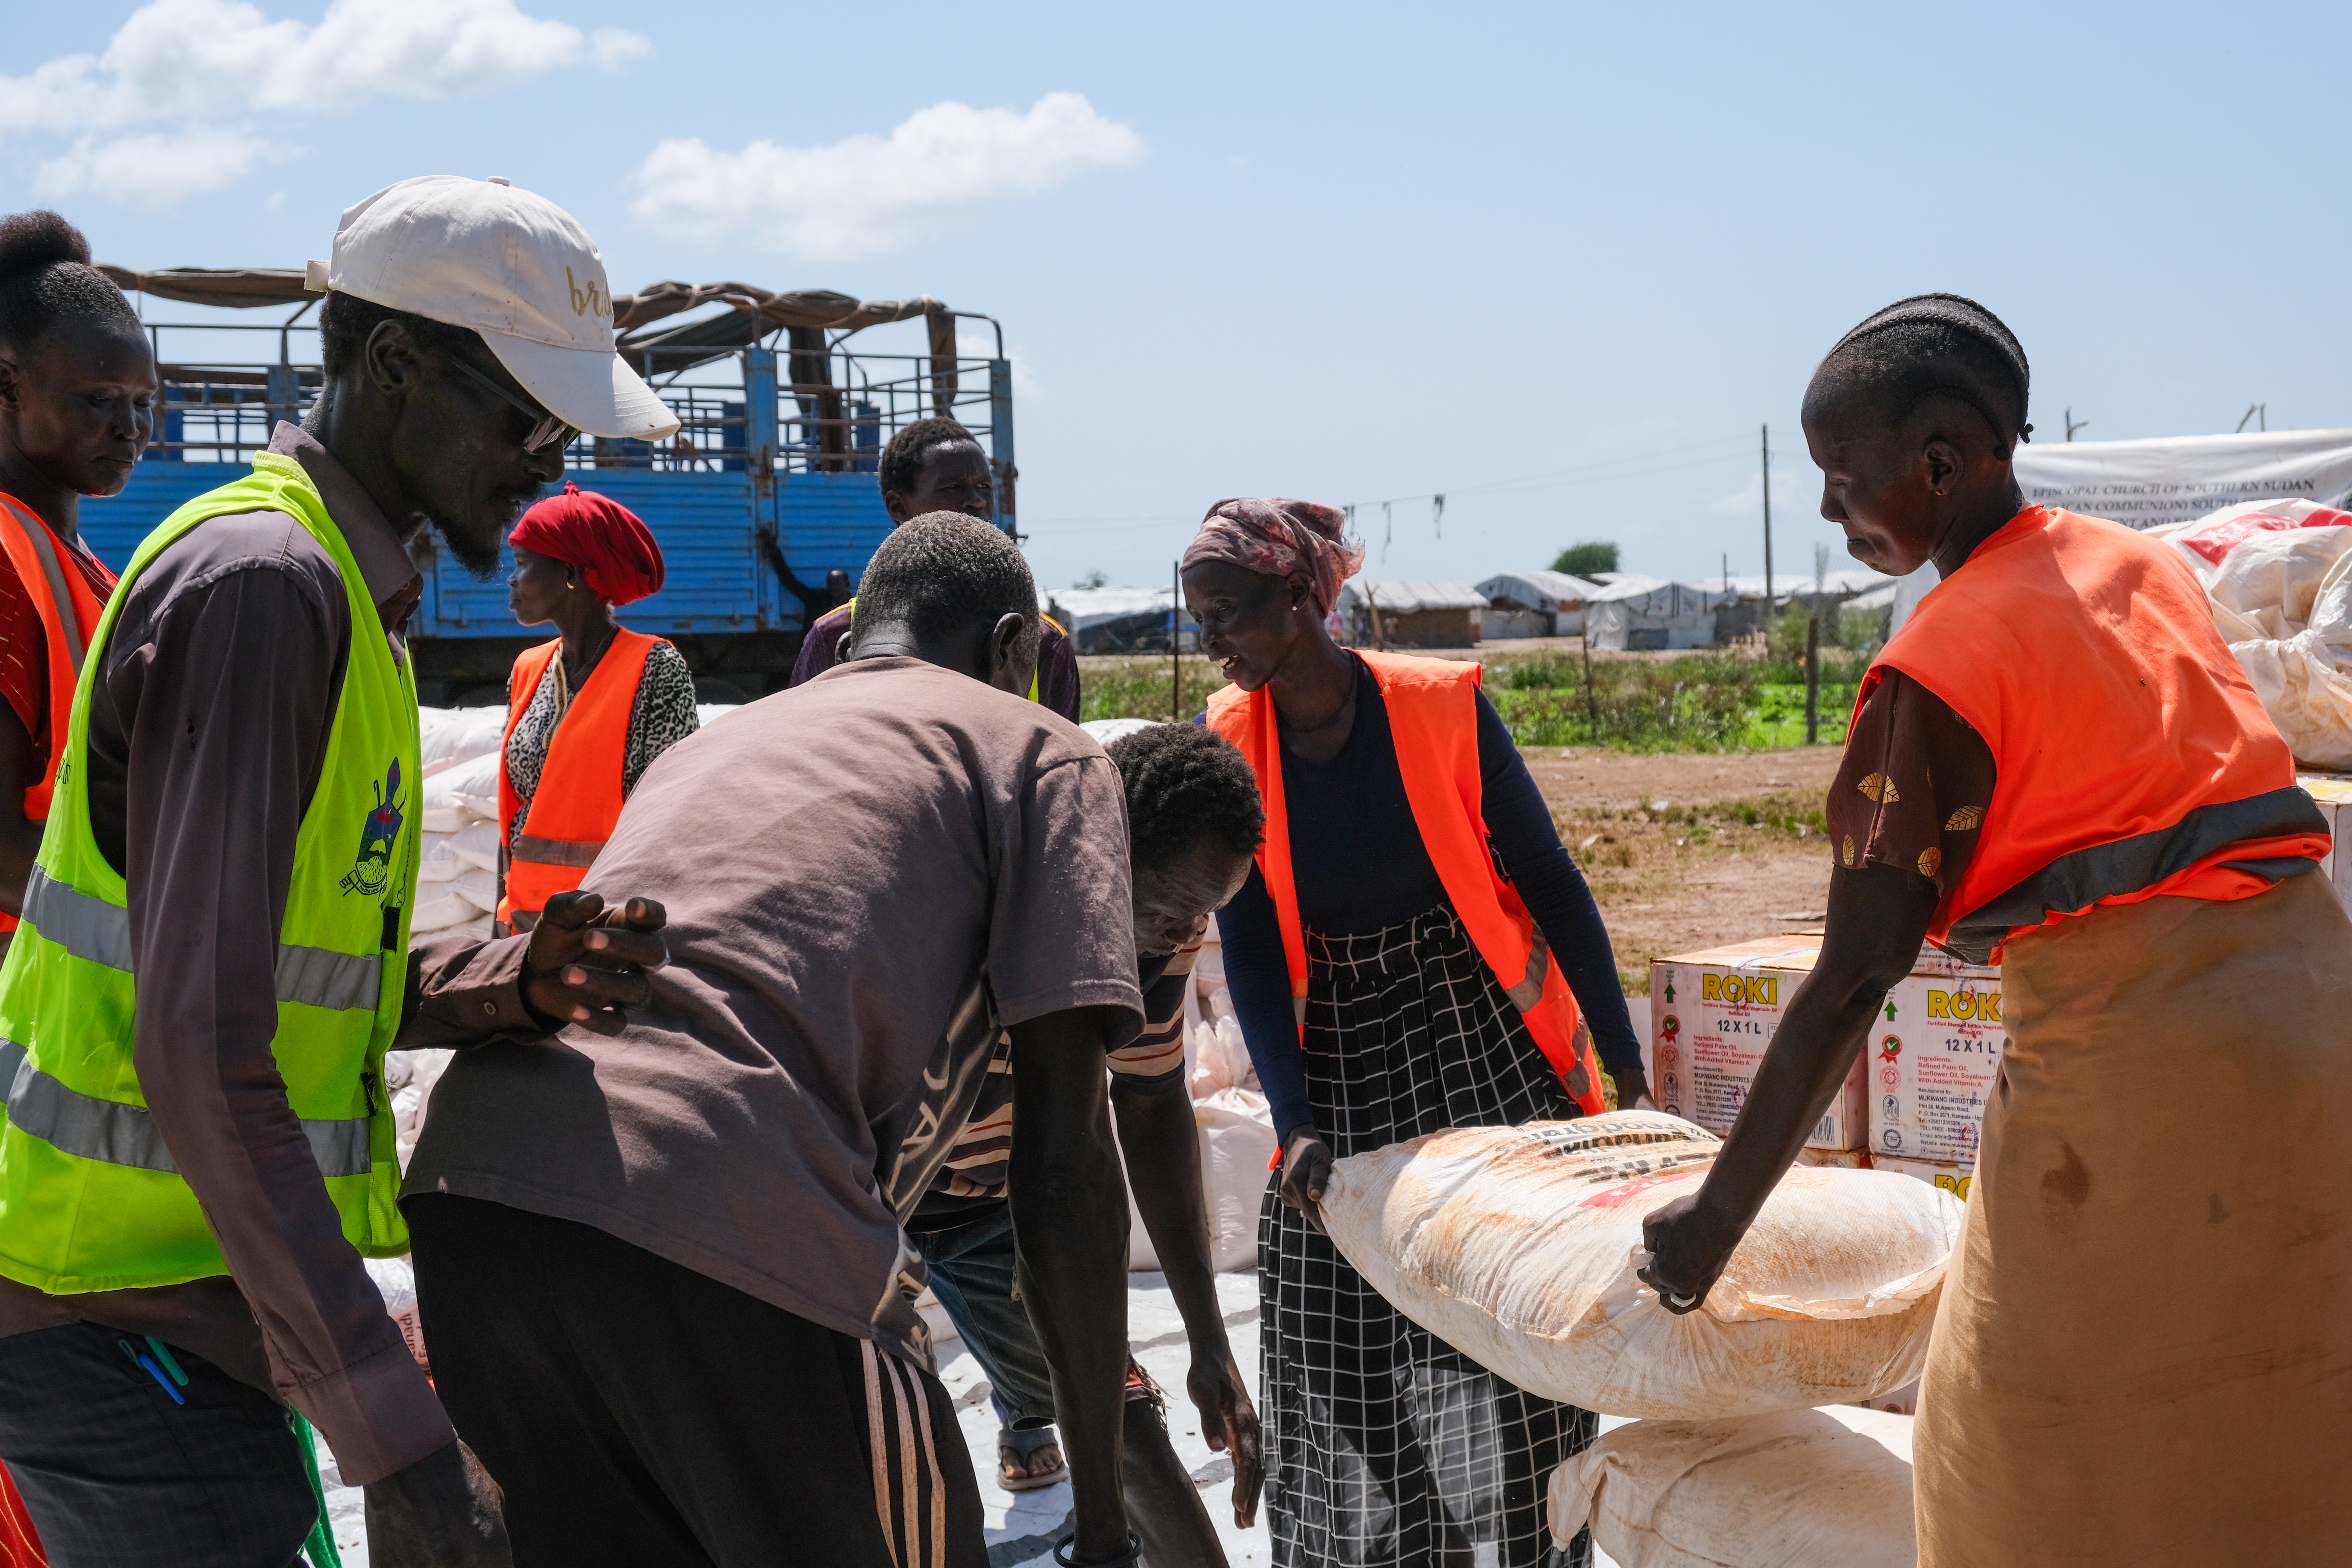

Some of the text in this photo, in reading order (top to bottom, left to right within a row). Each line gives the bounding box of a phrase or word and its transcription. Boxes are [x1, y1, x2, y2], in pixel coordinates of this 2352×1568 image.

[2034, 478, 2315, 497] EPISCOPAL CHURCH OF SOUTHERN SUDAN
[2095, 498, 2188, 512] COMMUNION)
[1703, 973, 1777, 1005] ROKI
[1928, 989, 2002, 1022] ROK
[1718, 1020, 1761, 1035] 12 X 1 L
[1946, 1038, 1996, 1054] 12 X 1 L
[1731, 1051, 1757, 1060] Soyabean
[1721, 1075, 1750, 1083] INDUSTRIES
[1961, 1072, 1991, 1081] Soyabean
